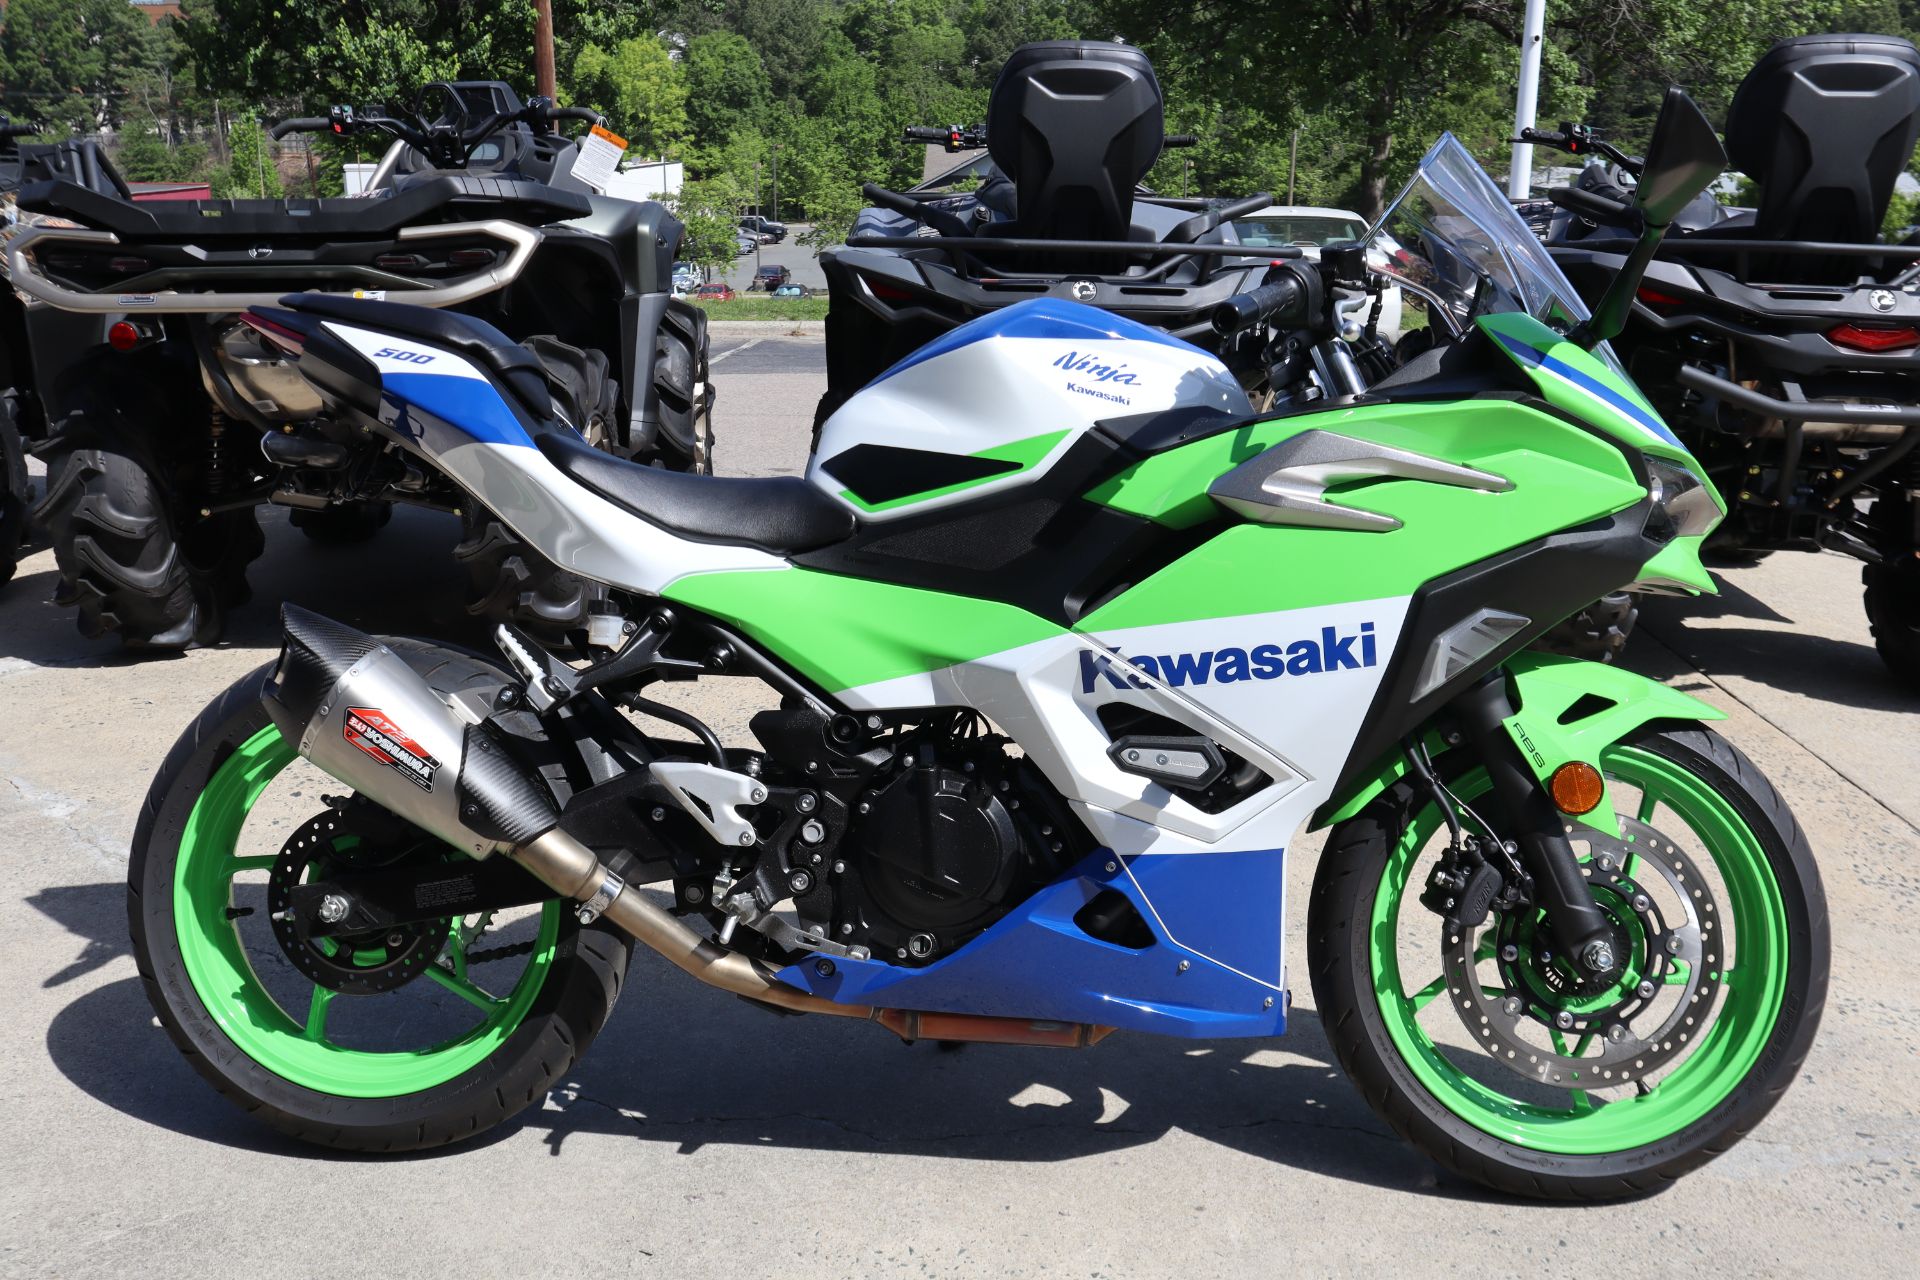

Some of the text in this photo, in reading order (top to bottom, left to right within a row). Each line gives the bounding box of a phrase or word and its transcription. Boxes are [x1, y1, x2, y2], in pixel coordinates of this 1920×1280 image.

[373, 347, 436, 364] 500
[1053, 351, 1142, 385] Ninja
[1067, 382, 1132, 406] Kawasaki
[1079, 622, 1377, 693] Kawasaki
[364, 727, 431, 778] YOSHIMURA
[1513, 722, 1545, 768] ABS
